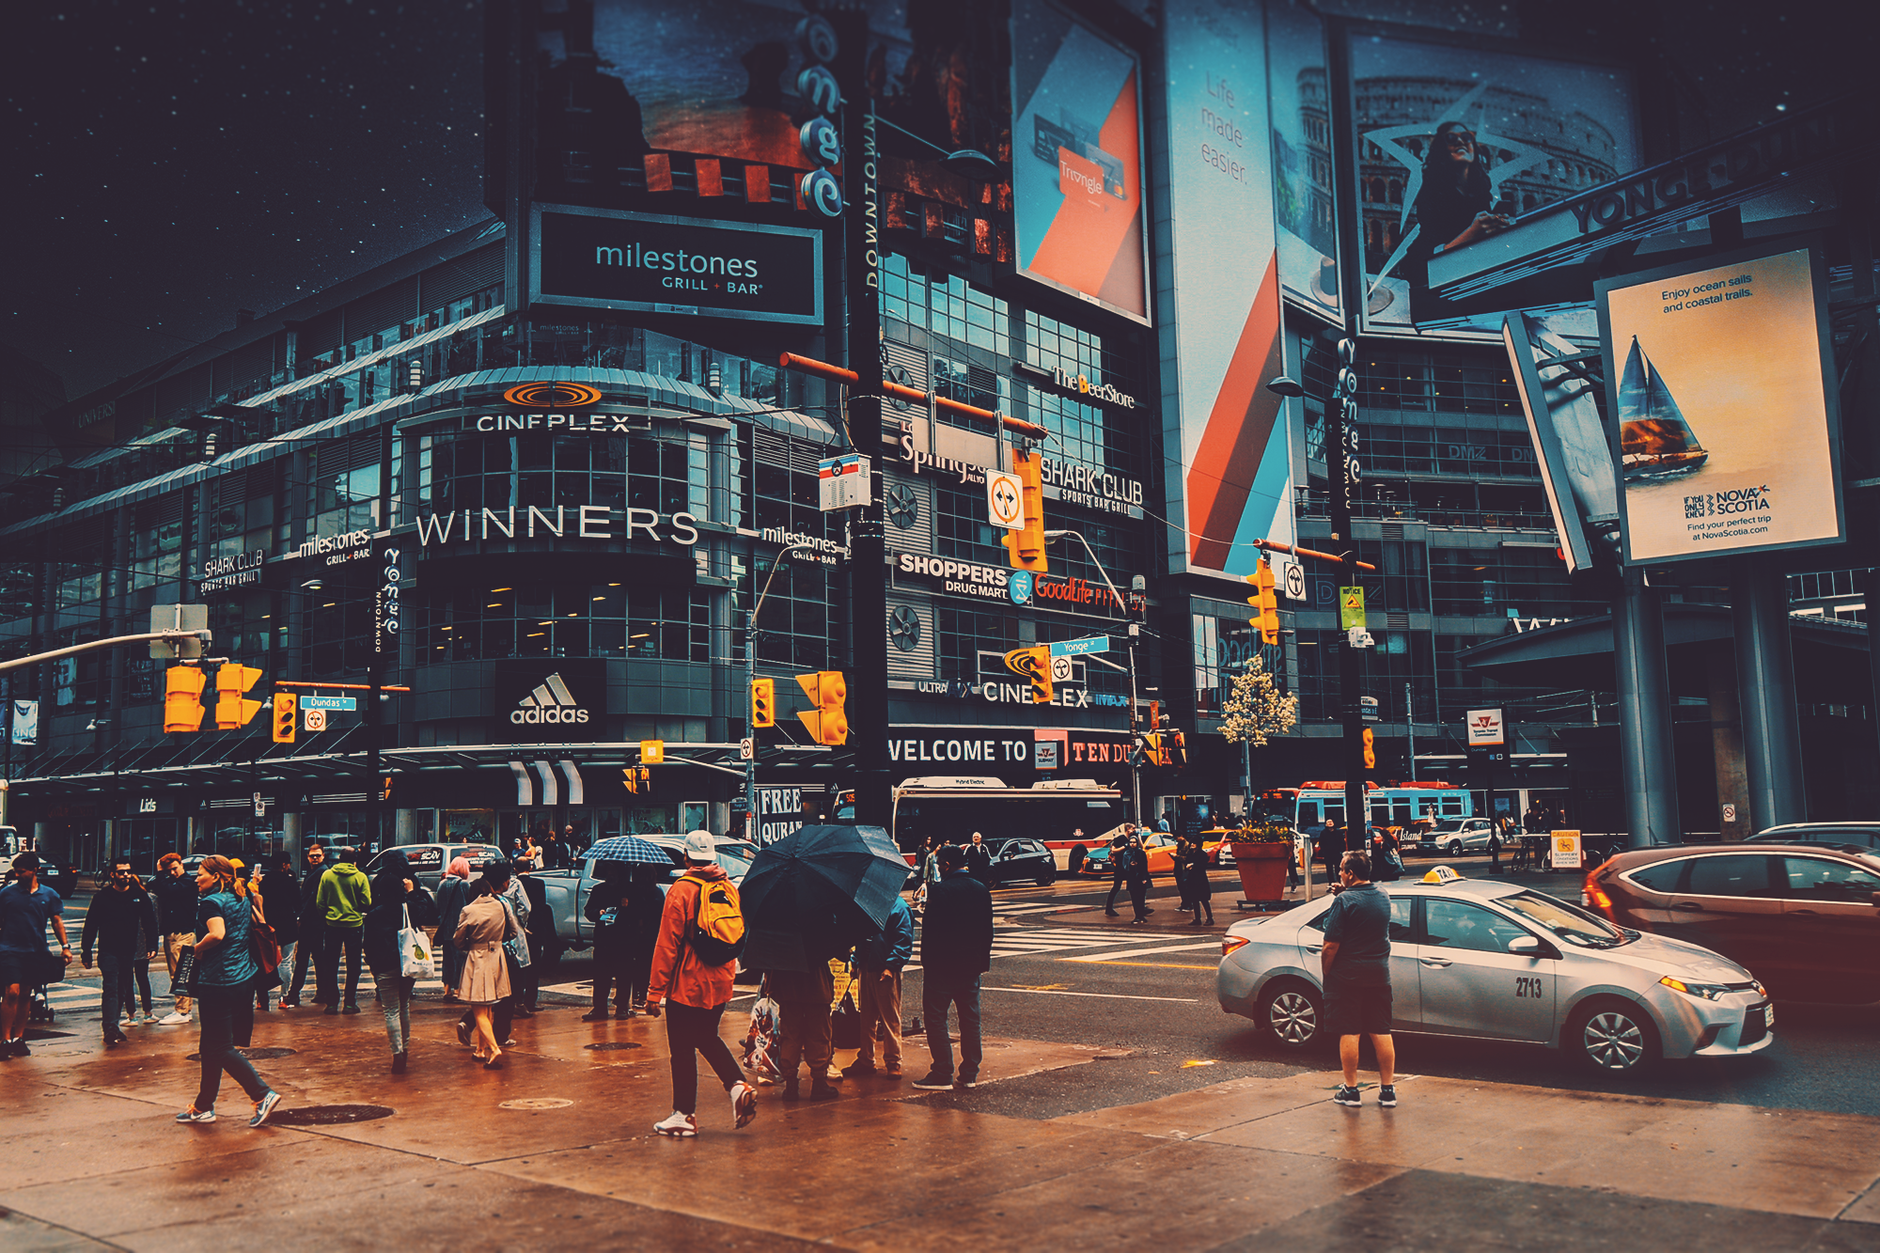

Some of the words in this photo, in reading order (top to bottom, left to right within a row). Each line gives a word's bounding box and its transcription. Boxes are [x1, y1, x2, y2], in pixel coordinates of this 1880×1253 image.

[1207, 70, 1234, 108] Life
[1202, 108, 1242, 148] made
[1201, 143, 1247, 185] easier.
[863, 113, 878, 289] DOWNTOWN
[597, 242, 758, 278] milestones
[662, 276, 708, 291] GRILL
[727, 281, 758, 295] BAR
[1662, 289, 1690, 300] Enjoy
[1692, 280, 1726, 294] ocean
[1728, 275, 1752, 286] sails
[1663, 302, 1683, 313] and
[1685, 293, 1722, 308] coastal
[1725, 289, 1753, 301] trails.
[476, 414, 630, 433] CINEPLEX
[1448, 440, 1486, 460] DMZ
[1041, 456, 1099, 495] SHARK
[1103, 473, 1143, 506] CLUB
[1062, 488, 1093, 506] SPORTS
[1111, 501, 1131, 515] GRILL
[1684, 504, 1704, 512] ONLY
[1717, 498, 1770, 515] SCOTIA
[1692, 494, 1704, 504] YOU
[1716, 488, 1758, 504] NOVA
[416, 504, 699, 547] WINNERS
[1685, 510, 1705, 519] KNEW
[1687, 523, 1705, 531] Find
[1707, 521, 1724, 531] your
[1727, 516, 1756, 528] perfect
[1758, 515, 1772, 524] trip
[299, 528, 371, 559] milestones
[762, 525, 838, 554] milestones
[1702, 526, 1768, 540] NovaScotia.com
[205, 555, 235, 579] SHARK
[238, 548, 263, 571] CLUB
[326, 553, 347, 566] GRILL
[353, 548, 371, 560] BAR
[821, 555, 837, 565] BAR
[899, 553, 1008, 587] SHOPPERS
[945, 581, 977, 595] DRUG
[978, 585, 1009, 600] MART
[1035, 572, 1092, 605] GoodLife
[1064, 642, 1089, 654] Yonge
[311, 698, 341, 707] Dundas
[918, 680, 949, 694] ULTRA
[1095, 693, 1127, 708] IMAX
[510, 705, 589, 724] adidas
[1001, 740, 1027, 761] TO
[1072, 742, 1110, 762] TEN
[140, 798, 157, 813] Lids
[760, 788, 802, 815] FREE
[1400, 828, 1422, 841] Island
[1516, 976, 1542, 999] 2713
